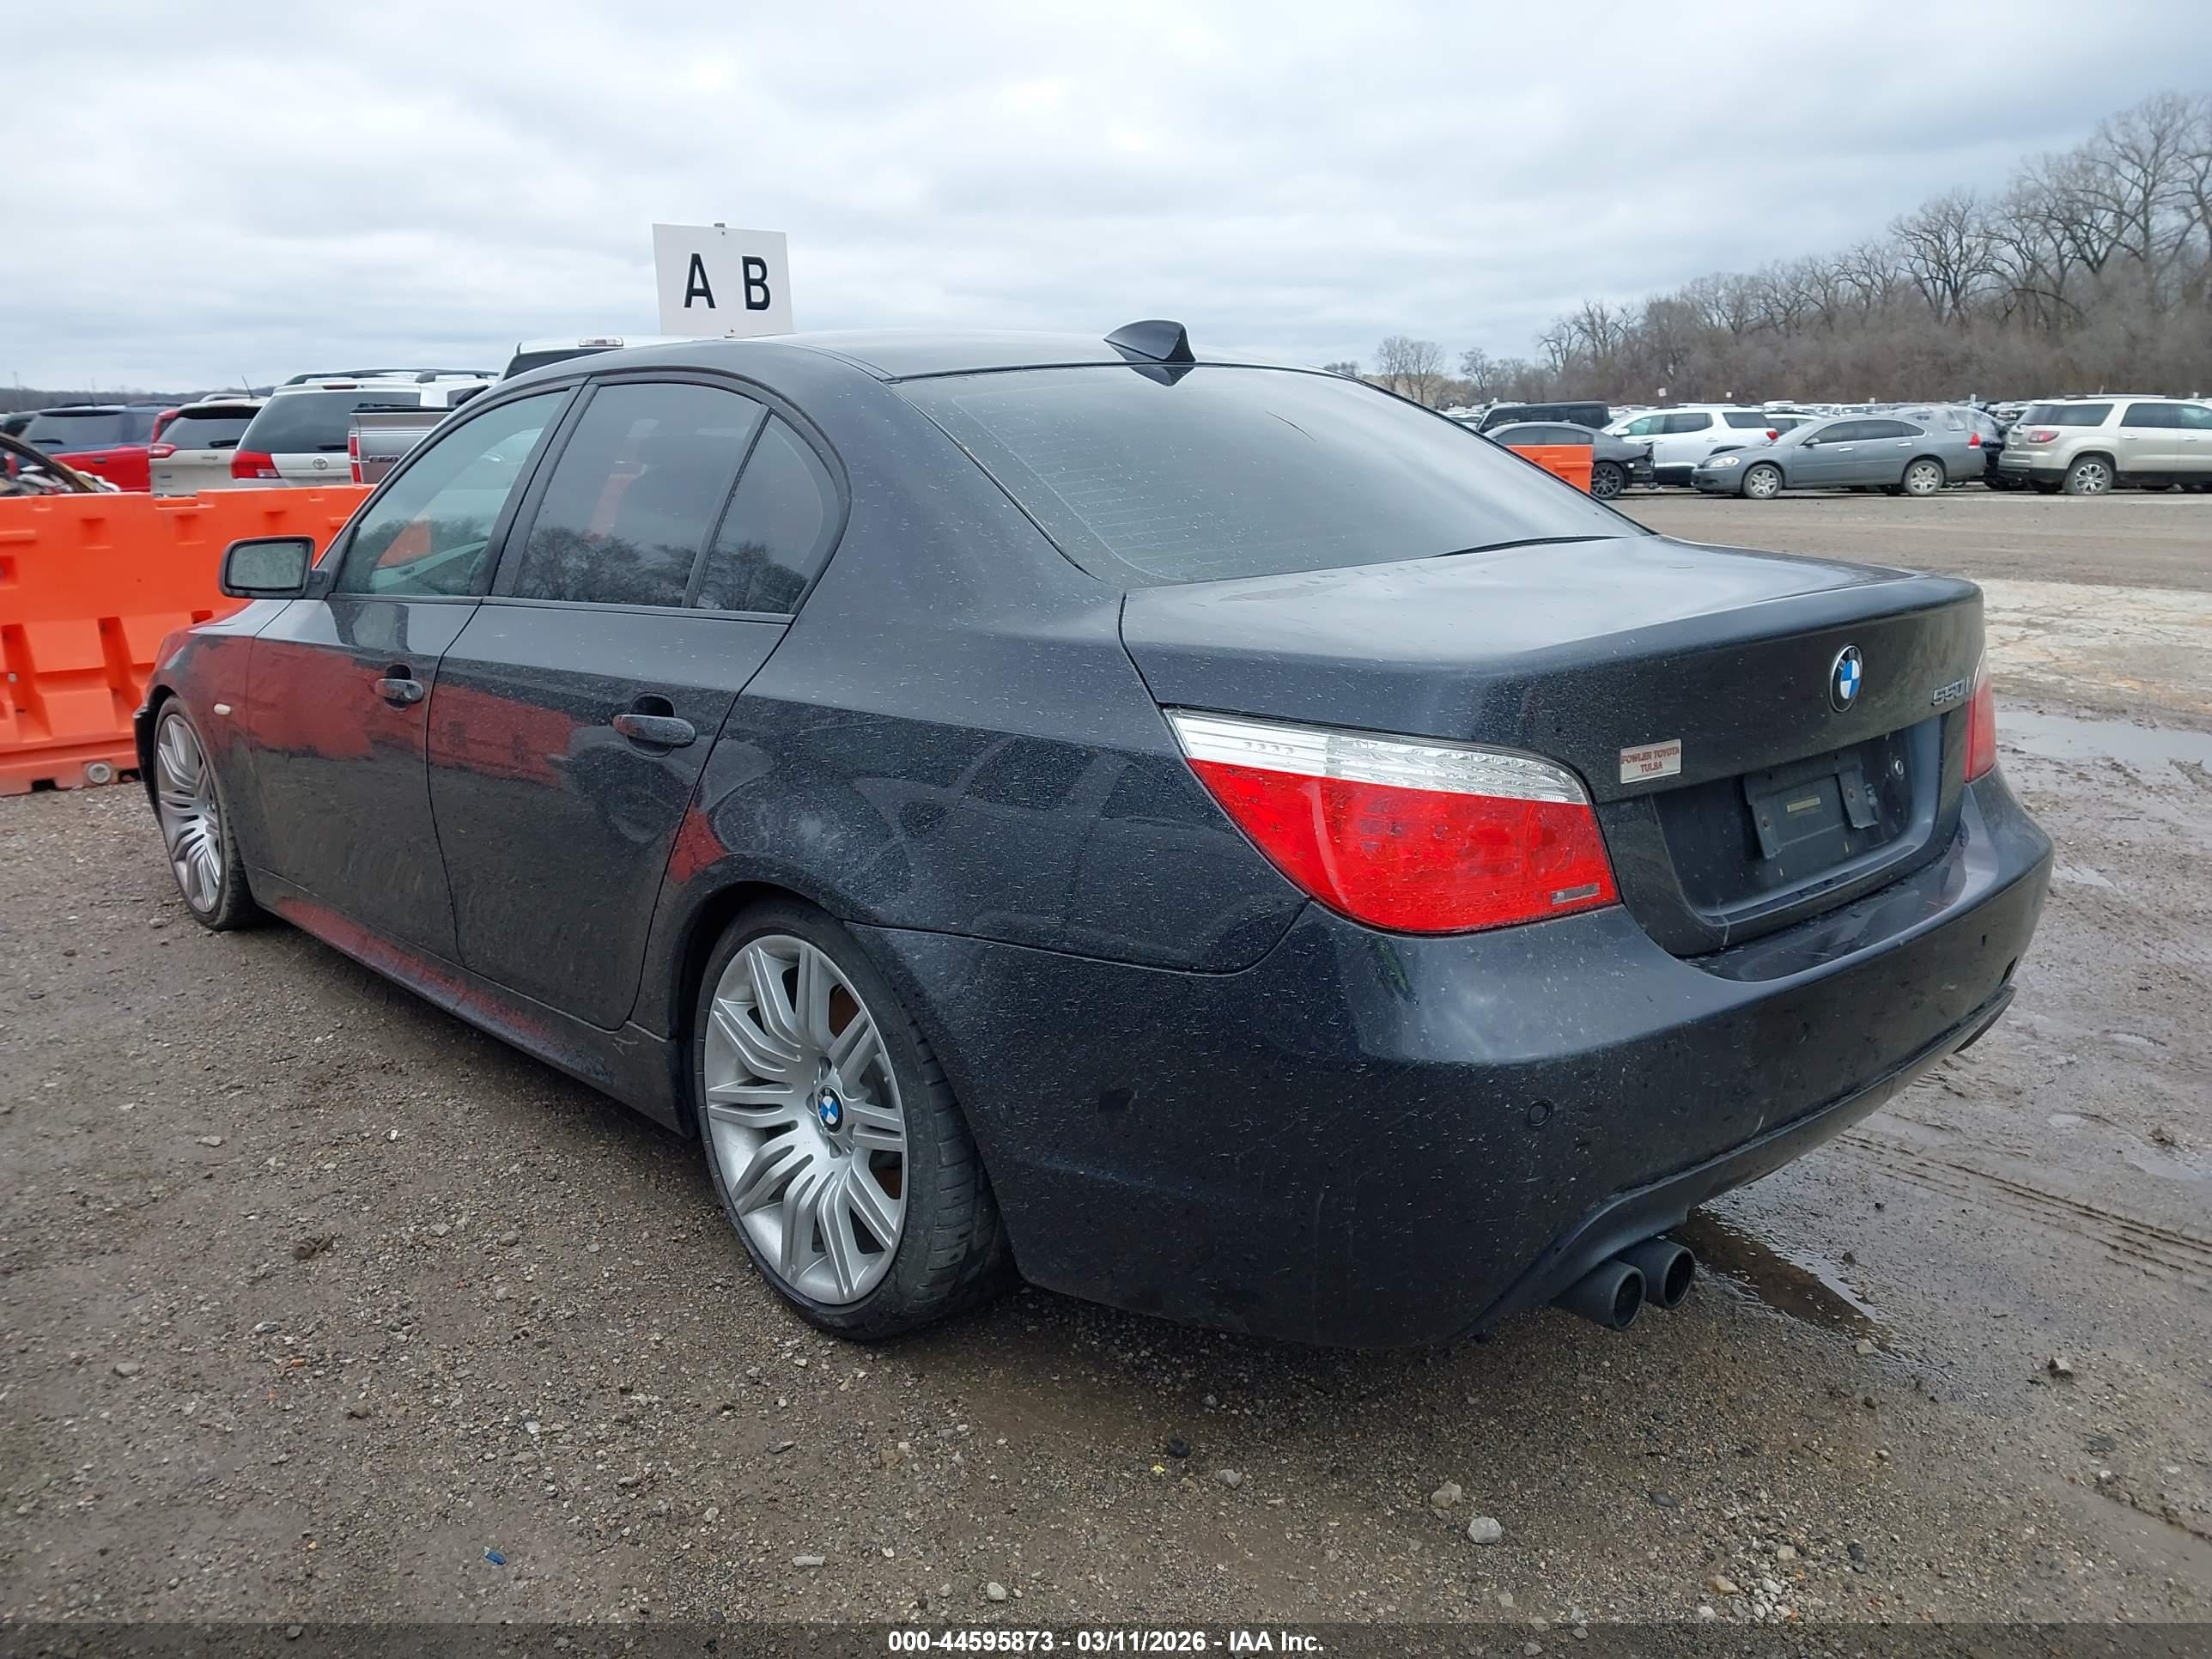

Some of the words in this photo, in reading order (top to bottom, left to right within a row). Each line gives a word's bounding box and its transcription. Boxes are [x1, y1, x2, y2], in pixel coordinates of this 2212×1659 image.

[684, 253, 716, 309] A
[742, 255, 770, 310] B
[1621, 750, 1652, 764] FOWLER
[1653, 746, 1680, 759] TOYOTA
[1640, 761, 1663, 773] TULSA
